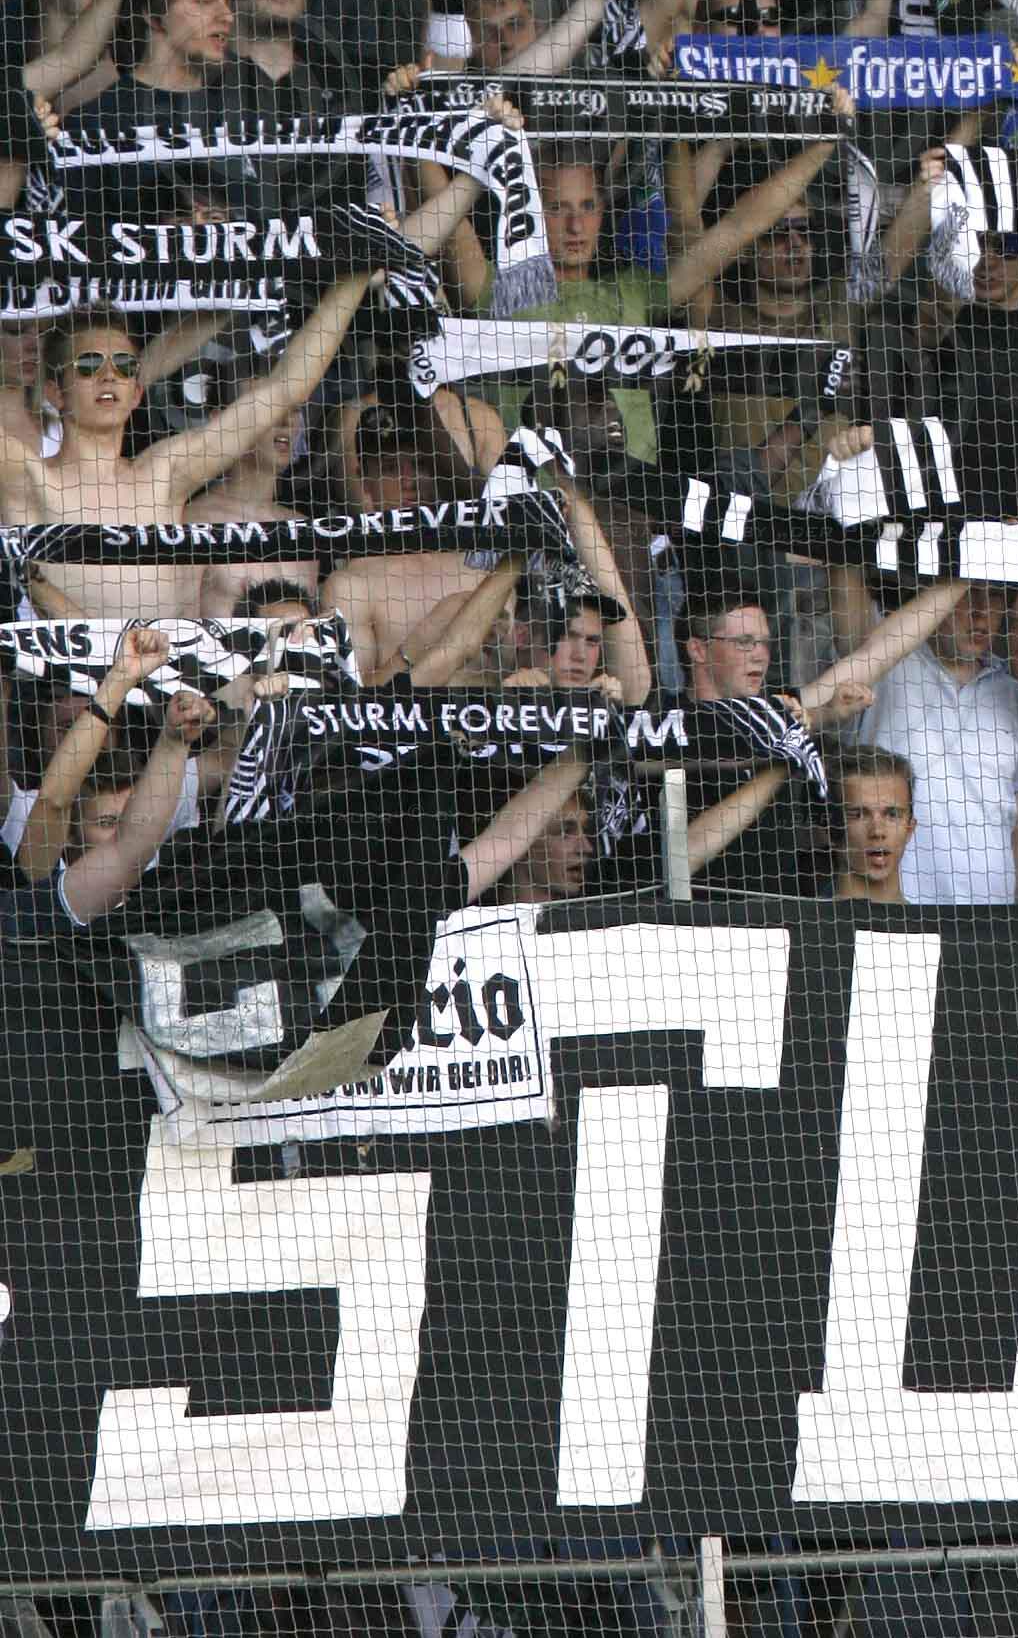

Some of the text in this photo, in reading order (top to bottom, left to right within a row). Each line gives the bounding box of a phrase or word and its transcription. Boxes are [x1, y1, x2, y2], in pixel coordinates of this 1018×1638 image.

[845, 45, 1002, 99] forever!
[5, 216, 321, 264] SK STURM
[102, 498, 508, 547] STURM FOREVER
[303, 705, 608, 740] STURM FOREVER
[391, 1066, 439, 1094] WIR
[447, 1062, 483, 1090] BEI
